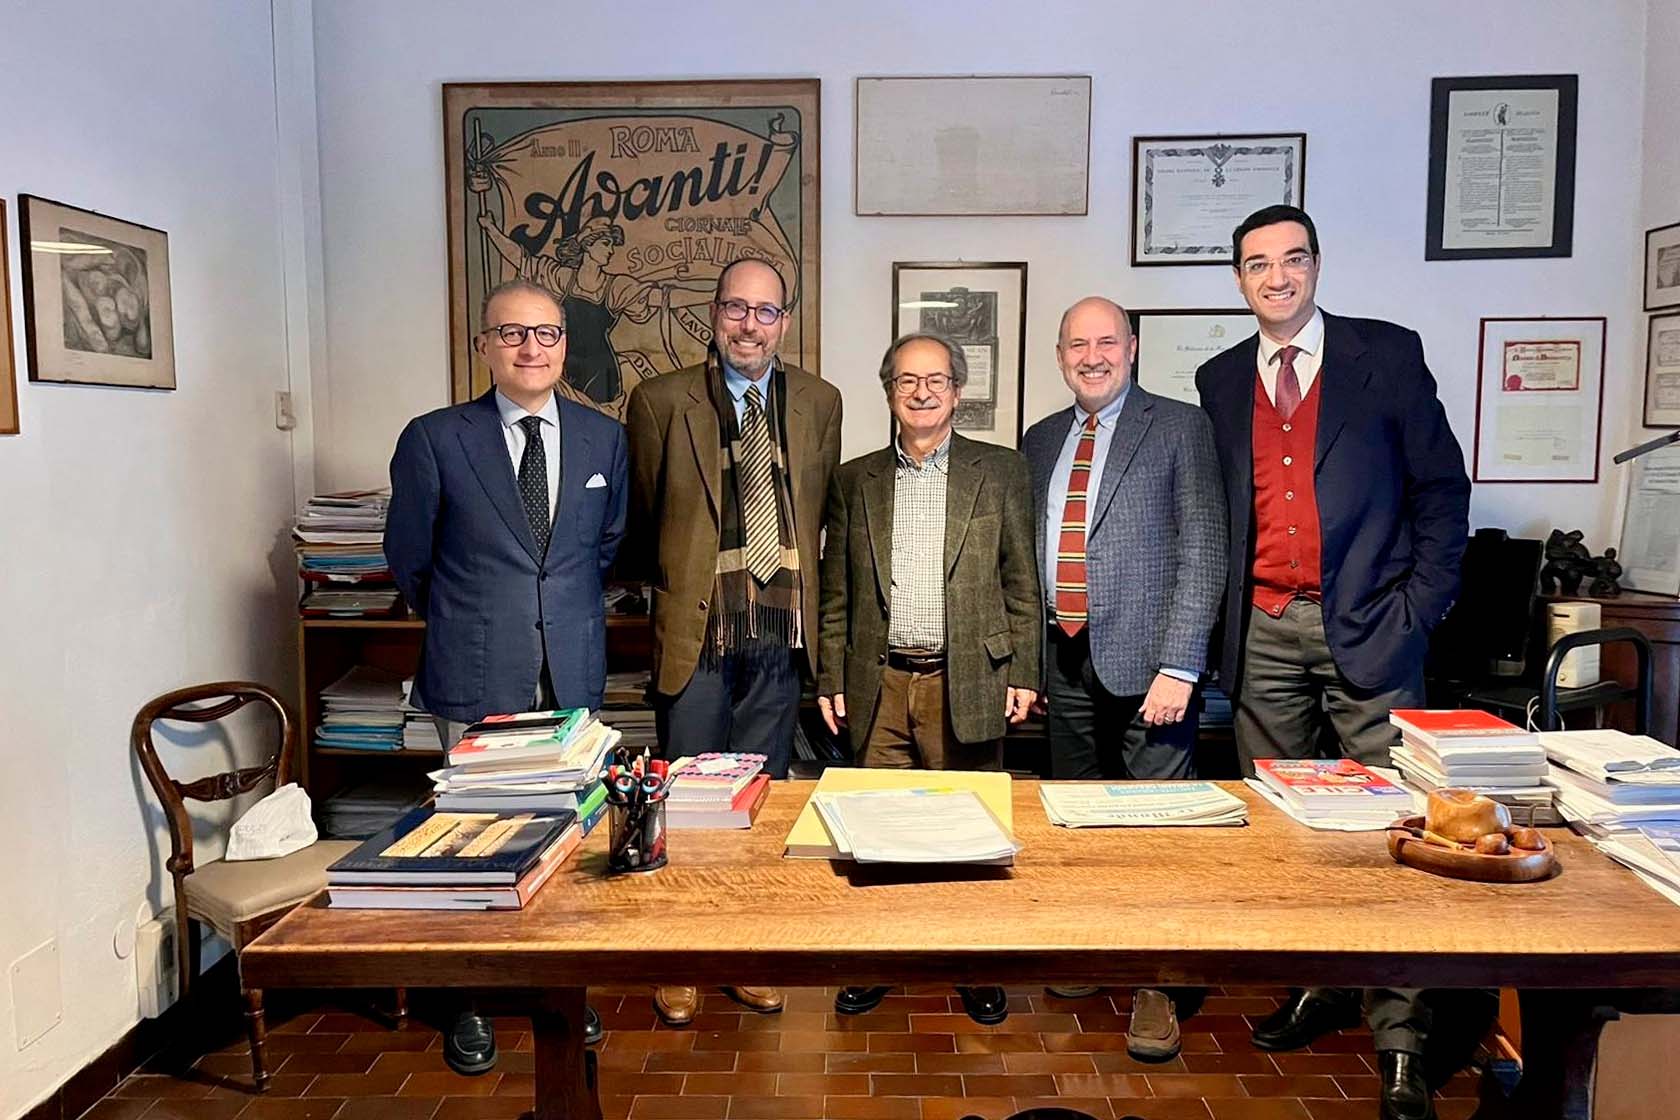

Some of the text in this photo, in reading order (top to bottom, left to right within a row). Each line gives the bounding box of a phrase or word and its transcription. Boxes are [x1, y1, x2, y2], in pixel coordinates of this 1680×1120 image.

[530, 137, 566, 158] Anno
[610, 126, 700, 159] ROMA
[510, 142, 774, 256] Avanti!
[664, 216, 752, 237] GIORNALE
